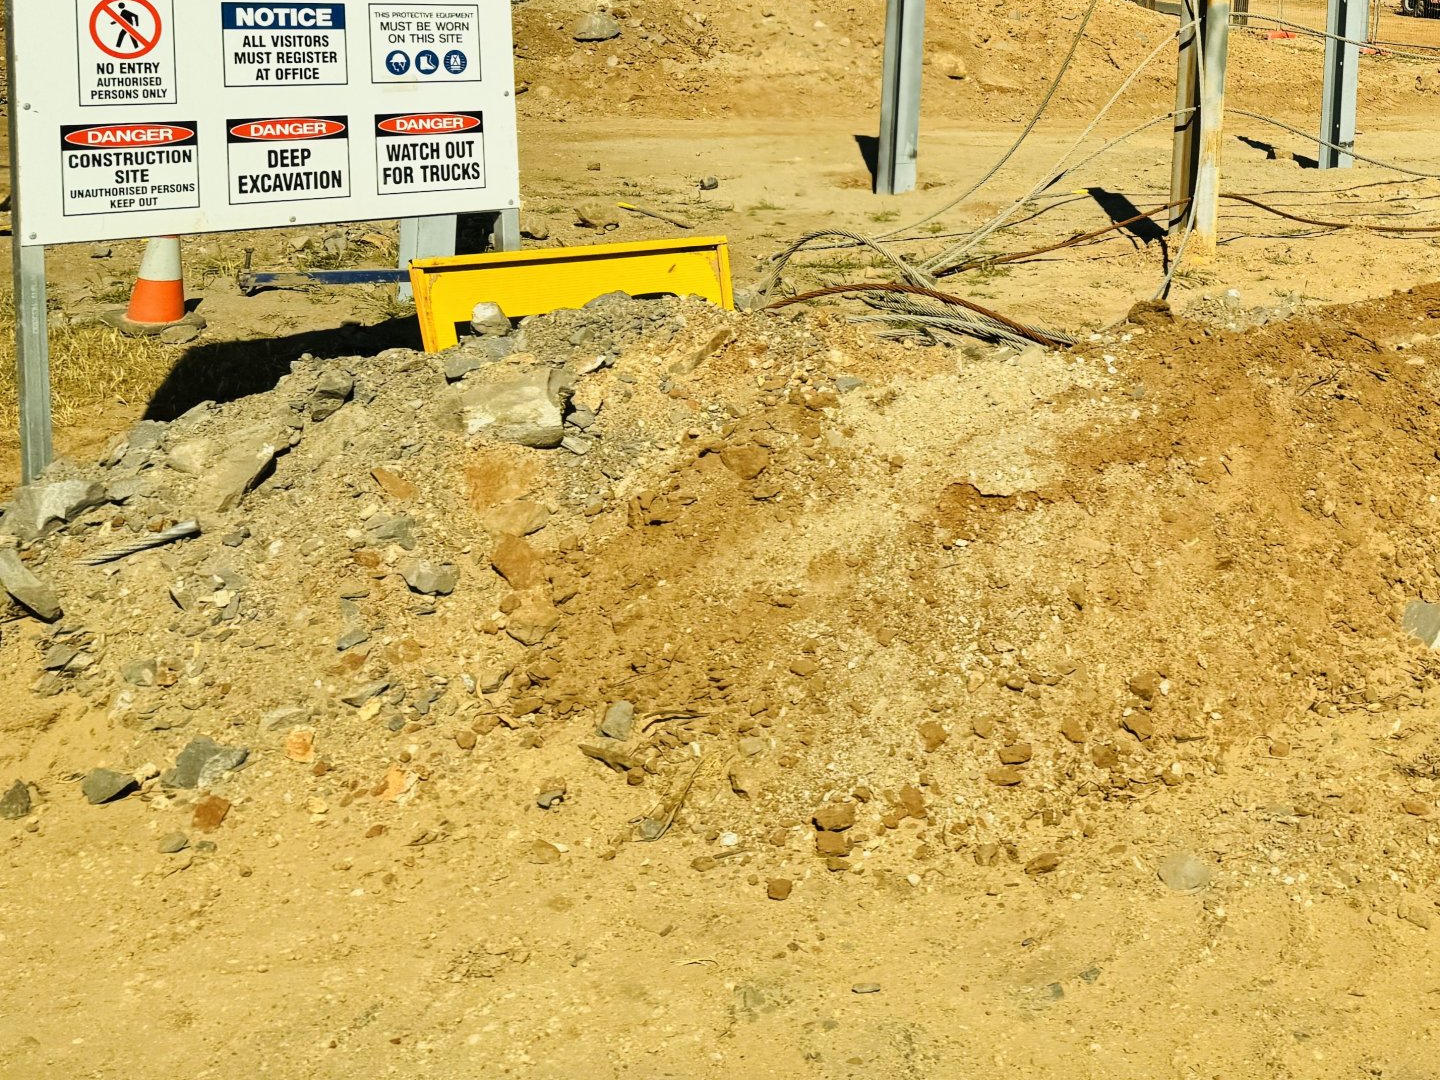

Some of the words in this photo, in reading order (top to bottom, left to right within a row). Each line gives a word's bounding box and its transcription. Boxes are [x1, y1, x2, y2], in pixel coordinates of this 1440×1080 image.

[235, 7, 333, 27] NOTICE
[374, 11, 390, 19] THIS
[392, 11, 433, 19] PROTECTIVE
[436, 11, 474, 19] EQUIPMENT
[380, 21, 412, 32] MUST
[416, 21, 431, 32] BE
[435, 21, 470, 32] WORN
[242, 35, 266, 48] ALL
[270, 34, 330, 48] VISITORS
[388, 33, 406, 44] ON
[409, 33, 435, 44] THIS
[439, 33, 463, 44] SITE
[233, 51, 272, 65] MUST
[276, 51, 338, 64] REGISTER
[96, 62, 115, 75] NO
[119, 62, 160, 75] ENTRY
[255, 67, 271, 81] AT
[275, 67, 320, 81] OFFICE
[96, 77, 162, 88] AUTHORISED
[90, 89, 139, 100] PERSONS
[142, 88, 167, 99] ONLY
[250, 122, 327, 137] DANGER
[395, 117, 465, 132] DANGER
[87, 128, 174, 144] DANGER
[267, 148, 312, 169] DEEP
[385, 141, 441, 162] WATCH
[445, 140, 475, 160] OUT
[67, 149, 193, 169] CONSTRUCTION
[114, 168, 150, 185] SITE
[382, 165, 415, 186] FOR
[419, 161, 481, 183] TRUCKS
[237, 169, 343, 195] EXCAVATION
[69, 185, 148, 199] UNAUTHORISED
[150, 182, 196, 195] PERSONS
[109, 198, 136, 210] KEEP
[138, 196, 159, 208] OUT
